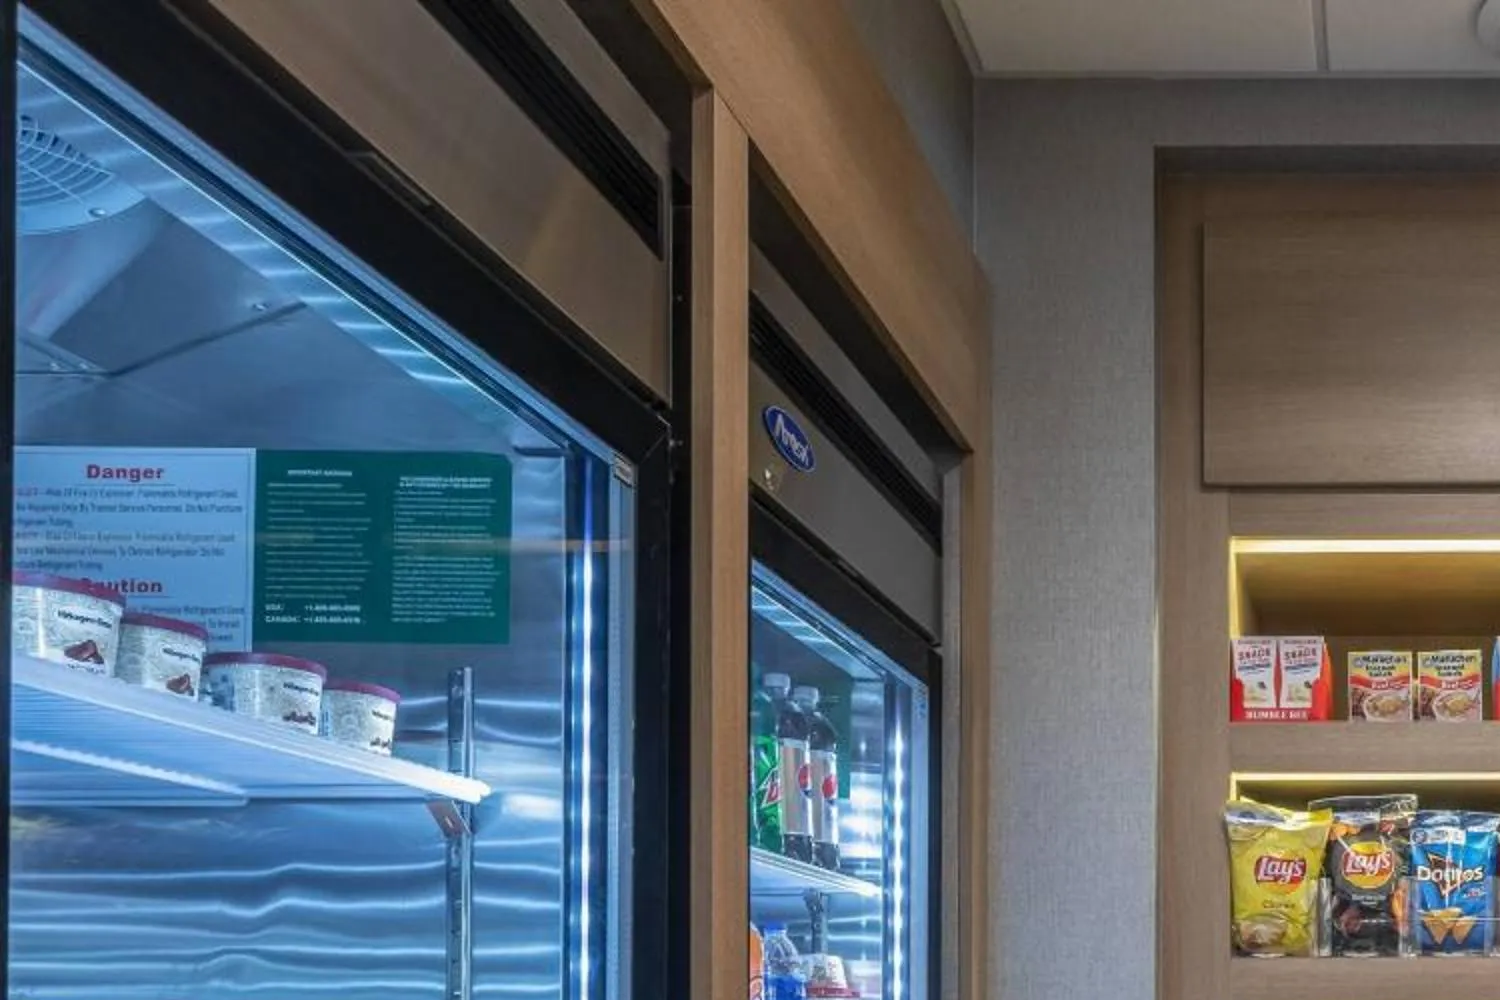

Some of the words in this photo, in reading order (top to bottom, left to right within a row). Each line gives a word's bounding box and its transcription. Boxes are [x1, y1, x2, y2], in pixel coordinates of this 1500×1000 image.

[86, 464, 165, 482] Danger
[1256, 855, 1307, 883] Lay's
[1344, 851, 1391, 876] Lay's
[1416, 865, 1484, 881] Doritos
